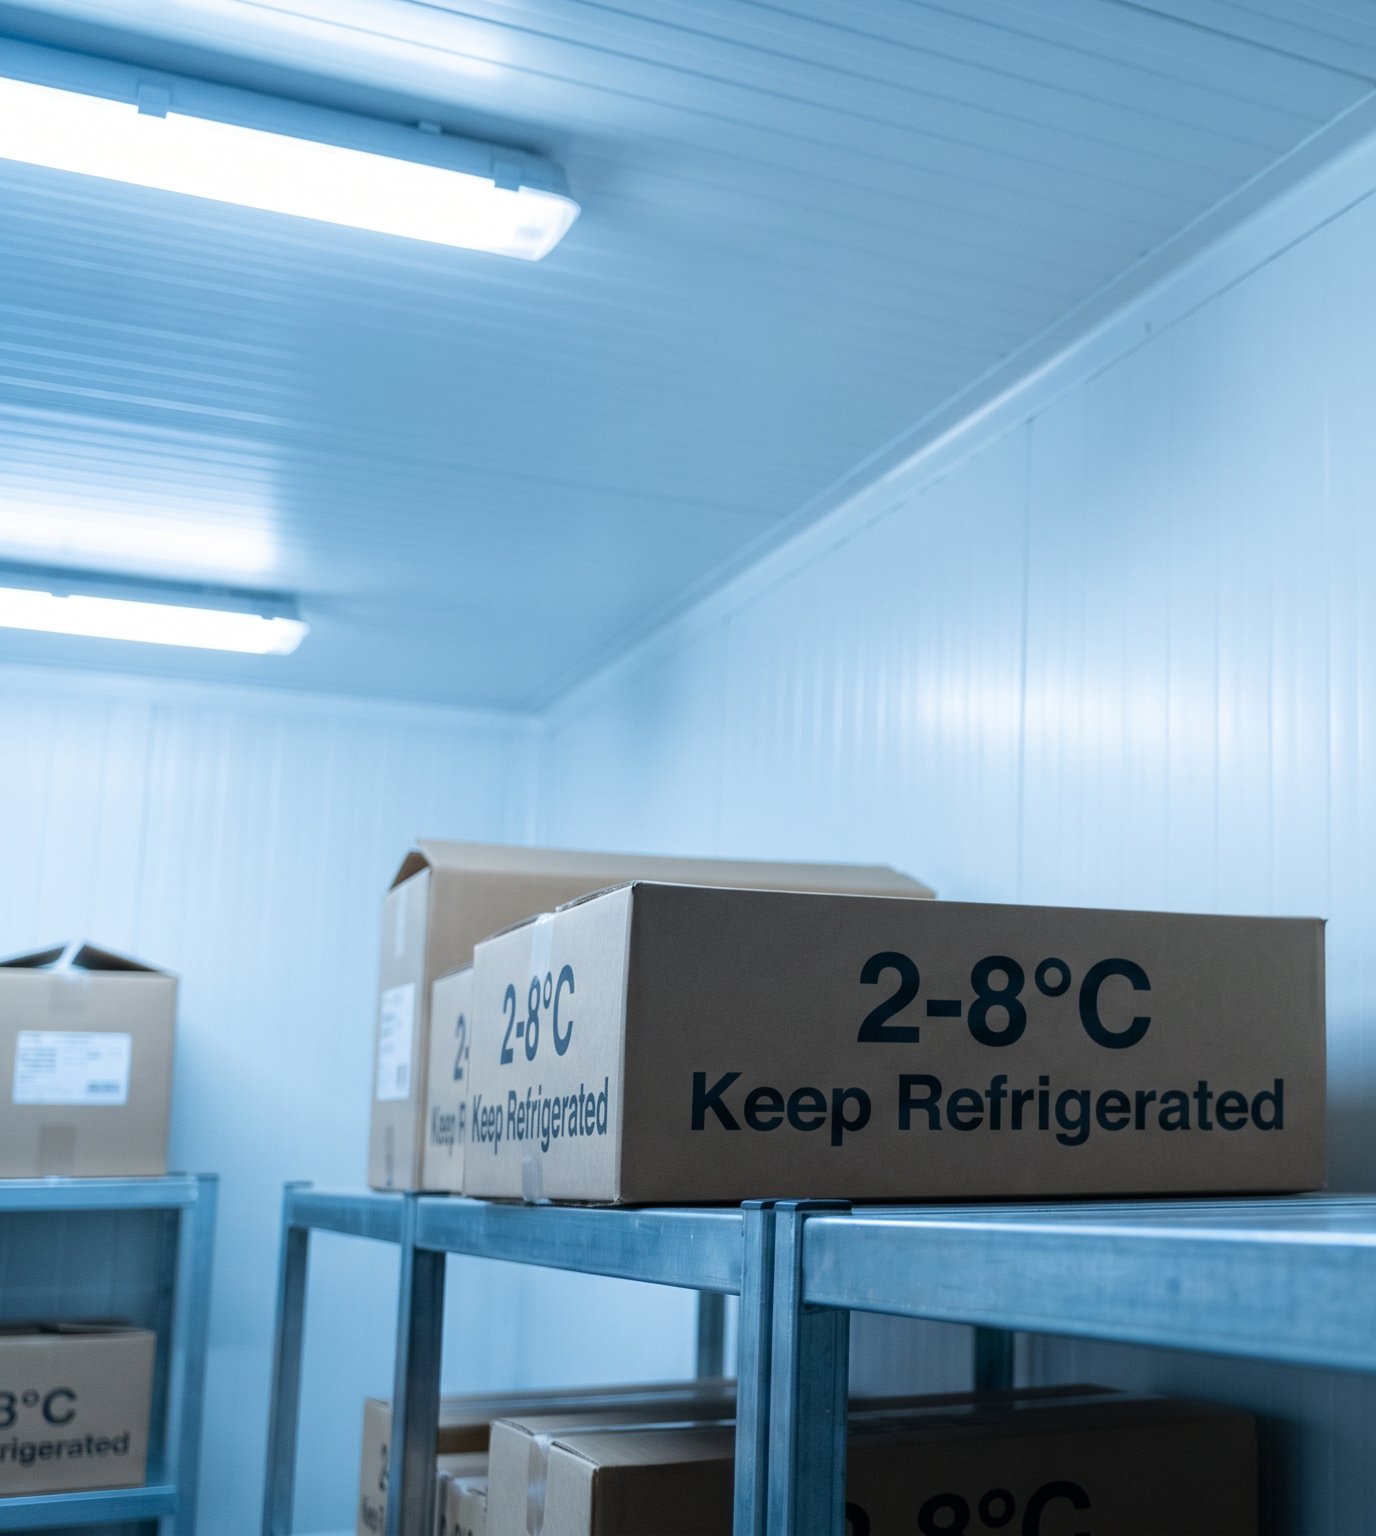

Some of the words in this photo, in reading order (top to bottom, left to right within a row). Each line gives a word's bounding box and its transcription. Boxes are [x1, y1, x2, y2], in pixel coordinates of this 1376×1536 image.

[500, 964, 575, 1065] 2-8°C
[857, 951, 1152, 1049] 2-8°C
[472, 1094, 503, 1155] Keep
[506, 1077, 609, 1153] Refrigerated
[690, 1071, 872, 1147] Keep
[898, 1074, 1284, 1147] Refrigerated
